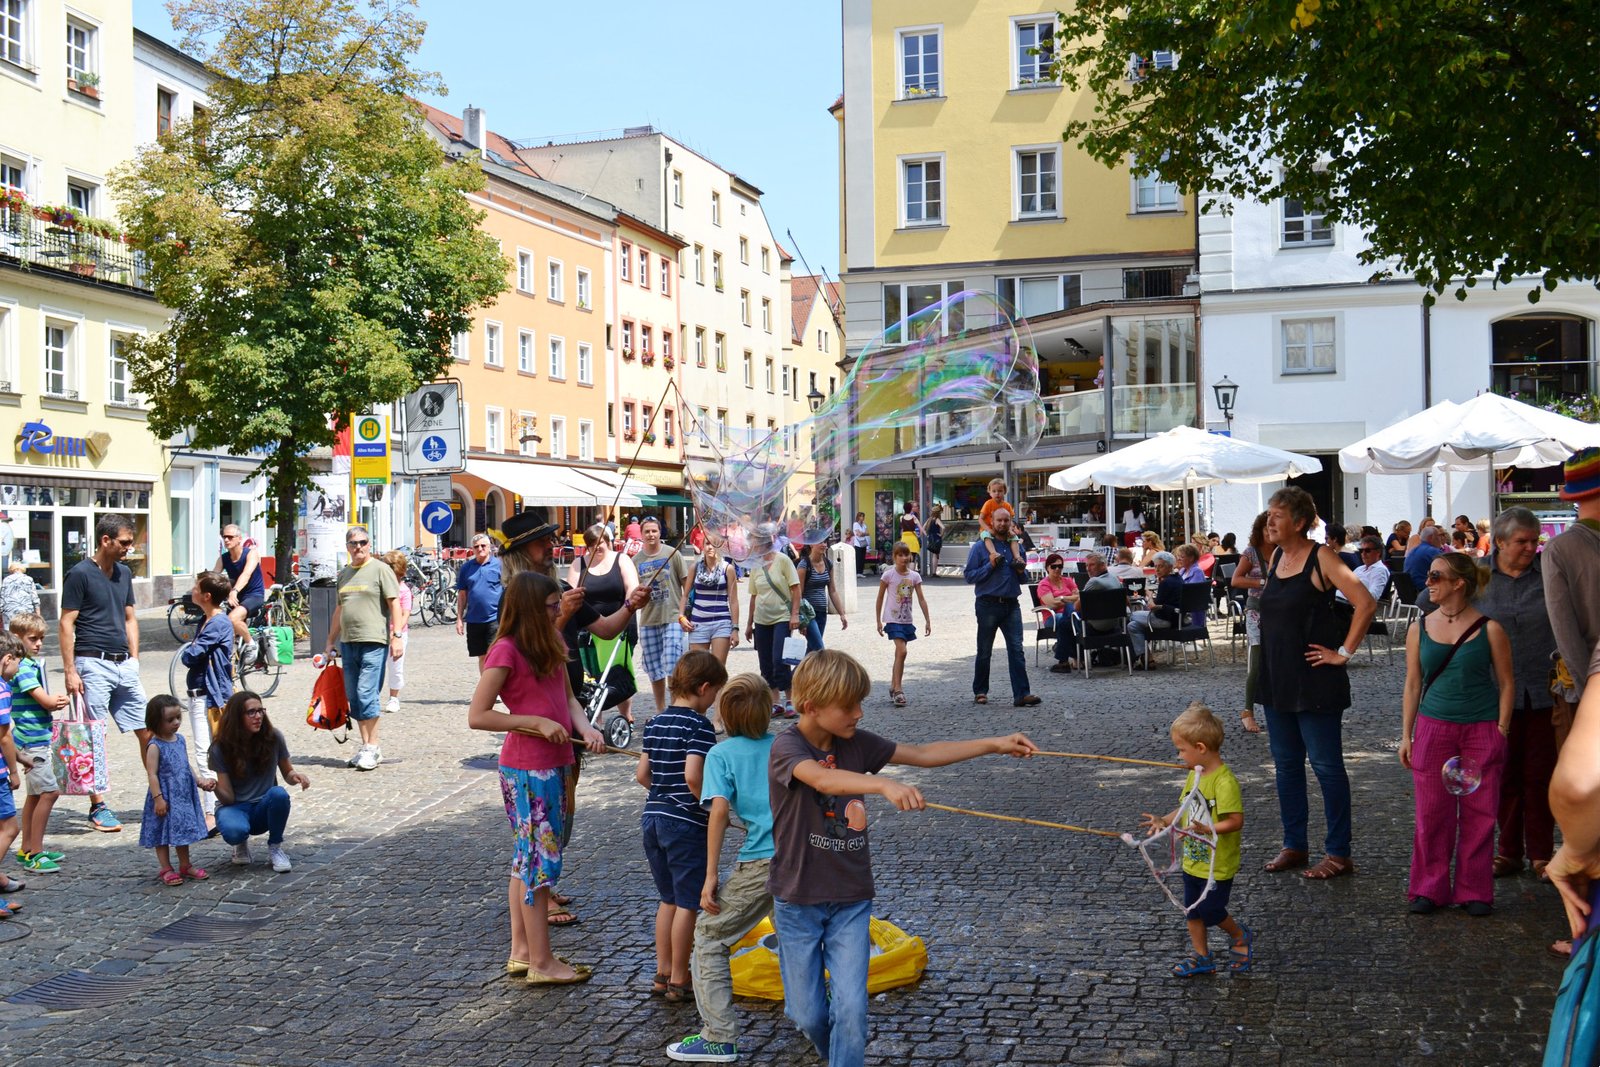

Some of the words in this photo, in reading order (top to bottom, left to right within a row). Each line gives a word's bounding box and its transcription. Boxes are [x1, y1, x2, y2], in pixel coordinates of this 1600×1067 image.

[423, 419, 443, 427] ZONE
[365, 424, 374, 436] H
[809, 833, 830, 849] MIND
[847, 836, 866, 851] GUM
